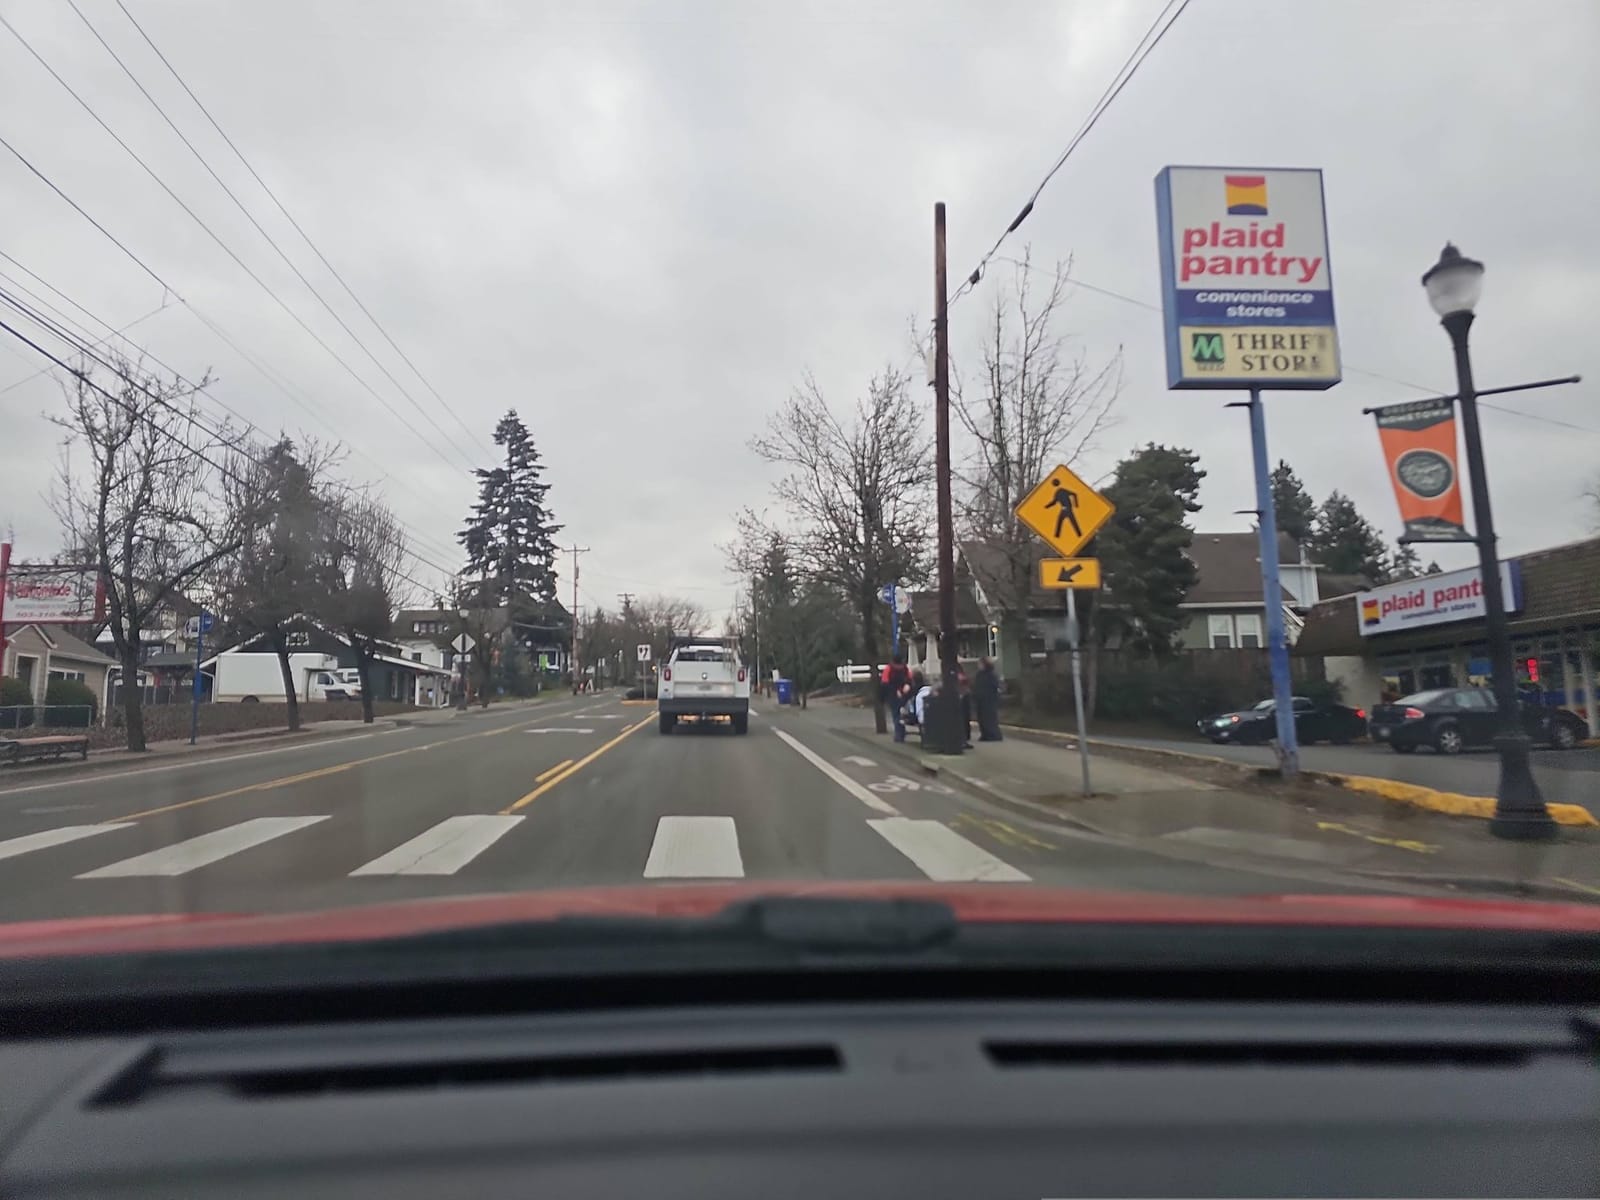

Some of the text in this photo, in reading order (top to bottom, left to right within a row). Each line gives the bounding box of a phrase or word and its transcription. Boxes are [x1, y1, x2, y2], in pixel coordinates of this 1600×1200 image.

[1183, 221, 1285, 253] plaid
[1180, 251, 1322, 283] pantry
[1196, 290, 1314, 304] convenience
[1226, 304, 1286, 318] stores
[1232, 333, 1326, 351] THRIFT
[1381, 578, 1486, 617] plaid pant
